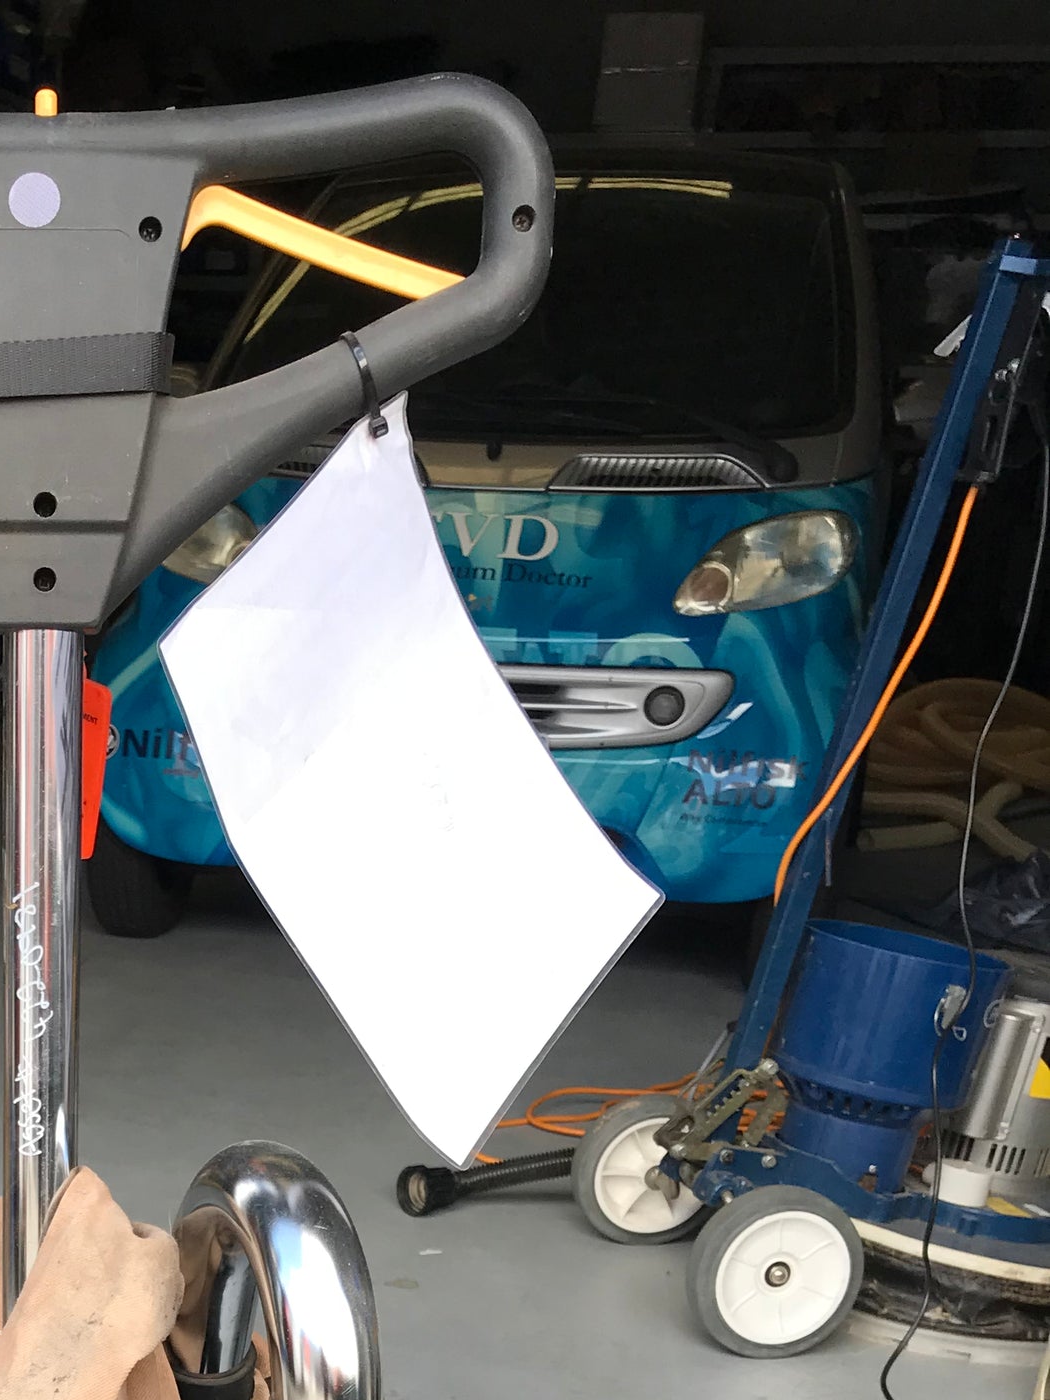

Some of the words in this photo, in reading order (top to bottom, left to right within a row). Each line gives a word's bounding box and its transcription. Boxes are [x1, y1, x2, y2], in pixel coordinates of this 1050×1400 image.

[432, 511, 559, 561] VD
[503, 563, 593, 588] Doctor
[687, 749, 808, 781] Nilfisk
[682, 778, 776, 810] ALTO
